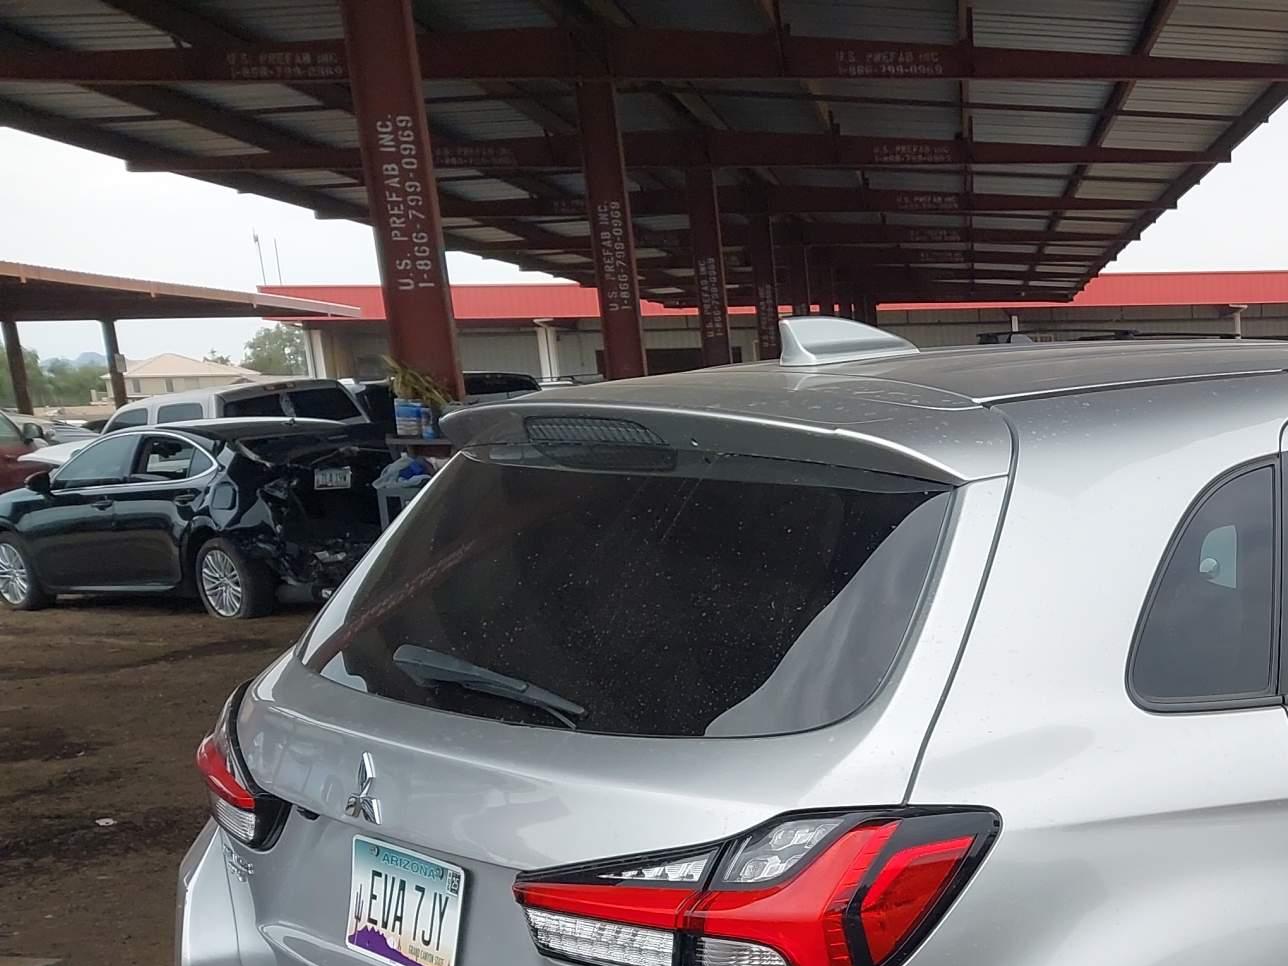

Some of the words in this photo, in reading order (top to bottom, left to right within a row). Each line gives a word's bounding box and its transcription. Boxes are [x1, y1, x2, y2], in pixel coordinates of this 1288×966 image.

[376, 114, 396, 152] INC.
[382, 163, 409, 241] PREFAB
[396, 115, 435, 288] 1-866-799-0969
[396, 253, 415, 291] U.S.
[600, 231, 617, 281] PREFAB
[382, 852, 437, 880] ARIZONA
[367, 869, 407, 936] EVA
[413, 884, 450, 951] 7JY
